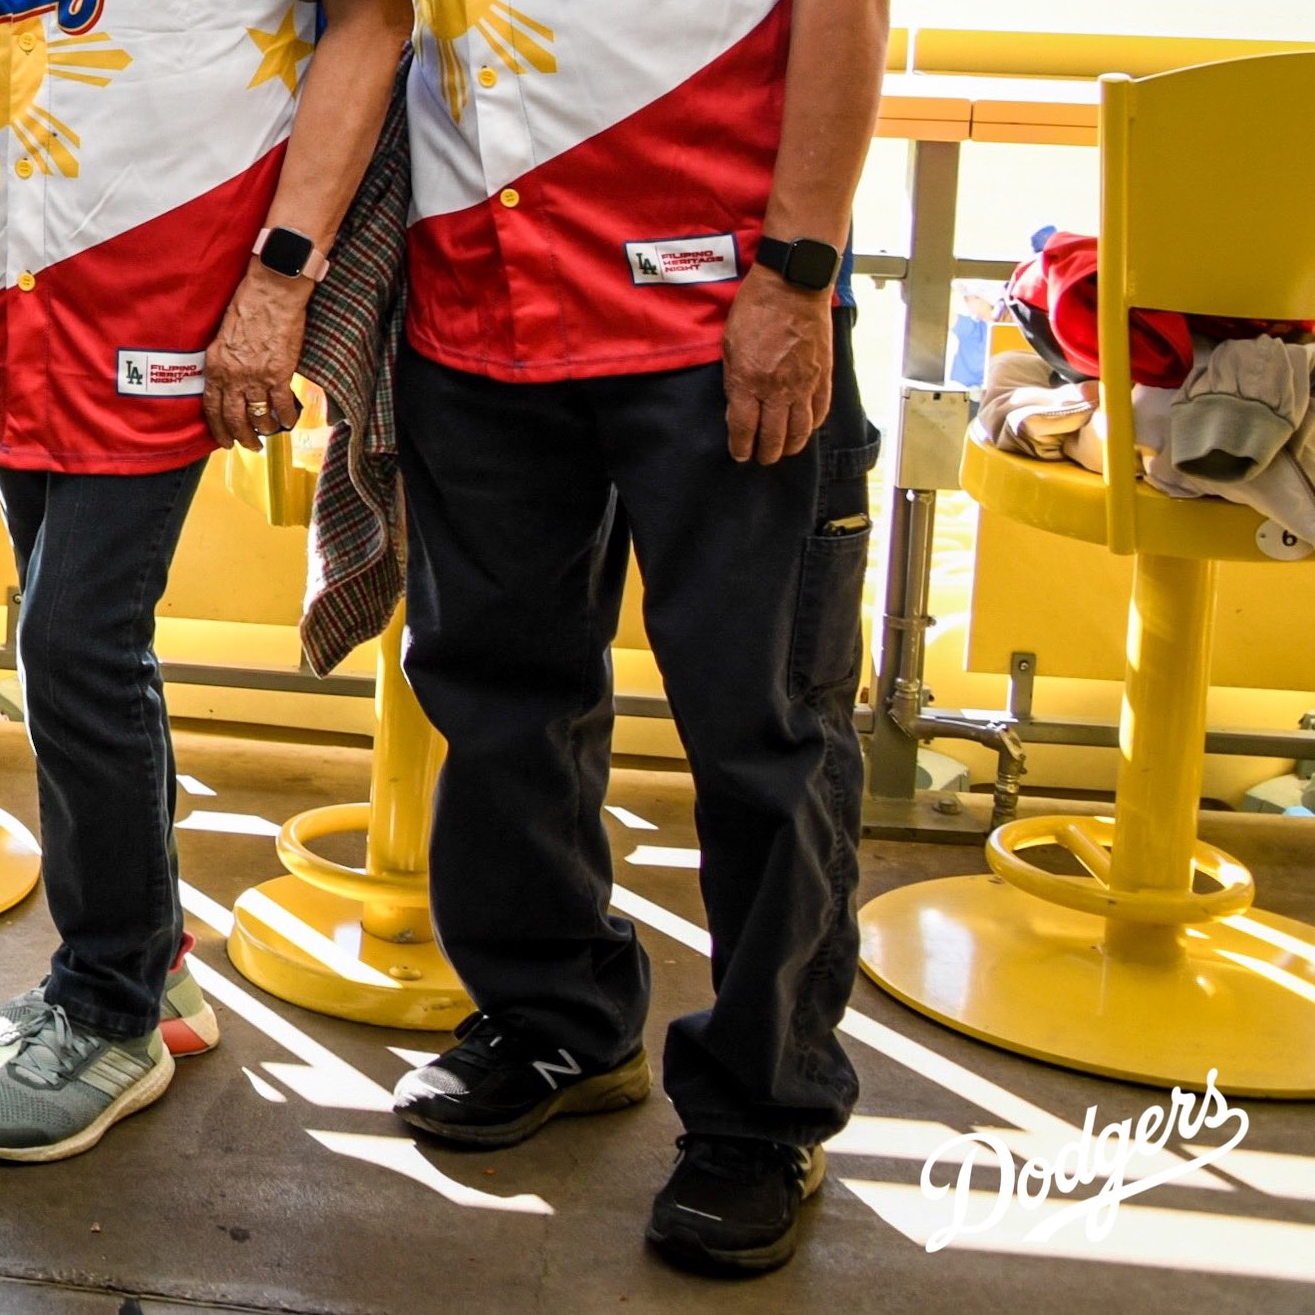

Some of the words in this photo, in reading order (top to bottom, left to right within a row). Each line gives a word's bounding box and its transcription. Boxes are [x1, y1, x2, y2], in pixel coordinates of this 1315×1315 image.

[662, 250, 714, 259] FILIPINO
[663, 256, 724, 266] HERITAGE
[636, 253, 658, 275] LA
[665, 264, 701, 273] NIGHT
[126, 360, 143, 385] LA
[1282, 529, 1298, 547] 6
